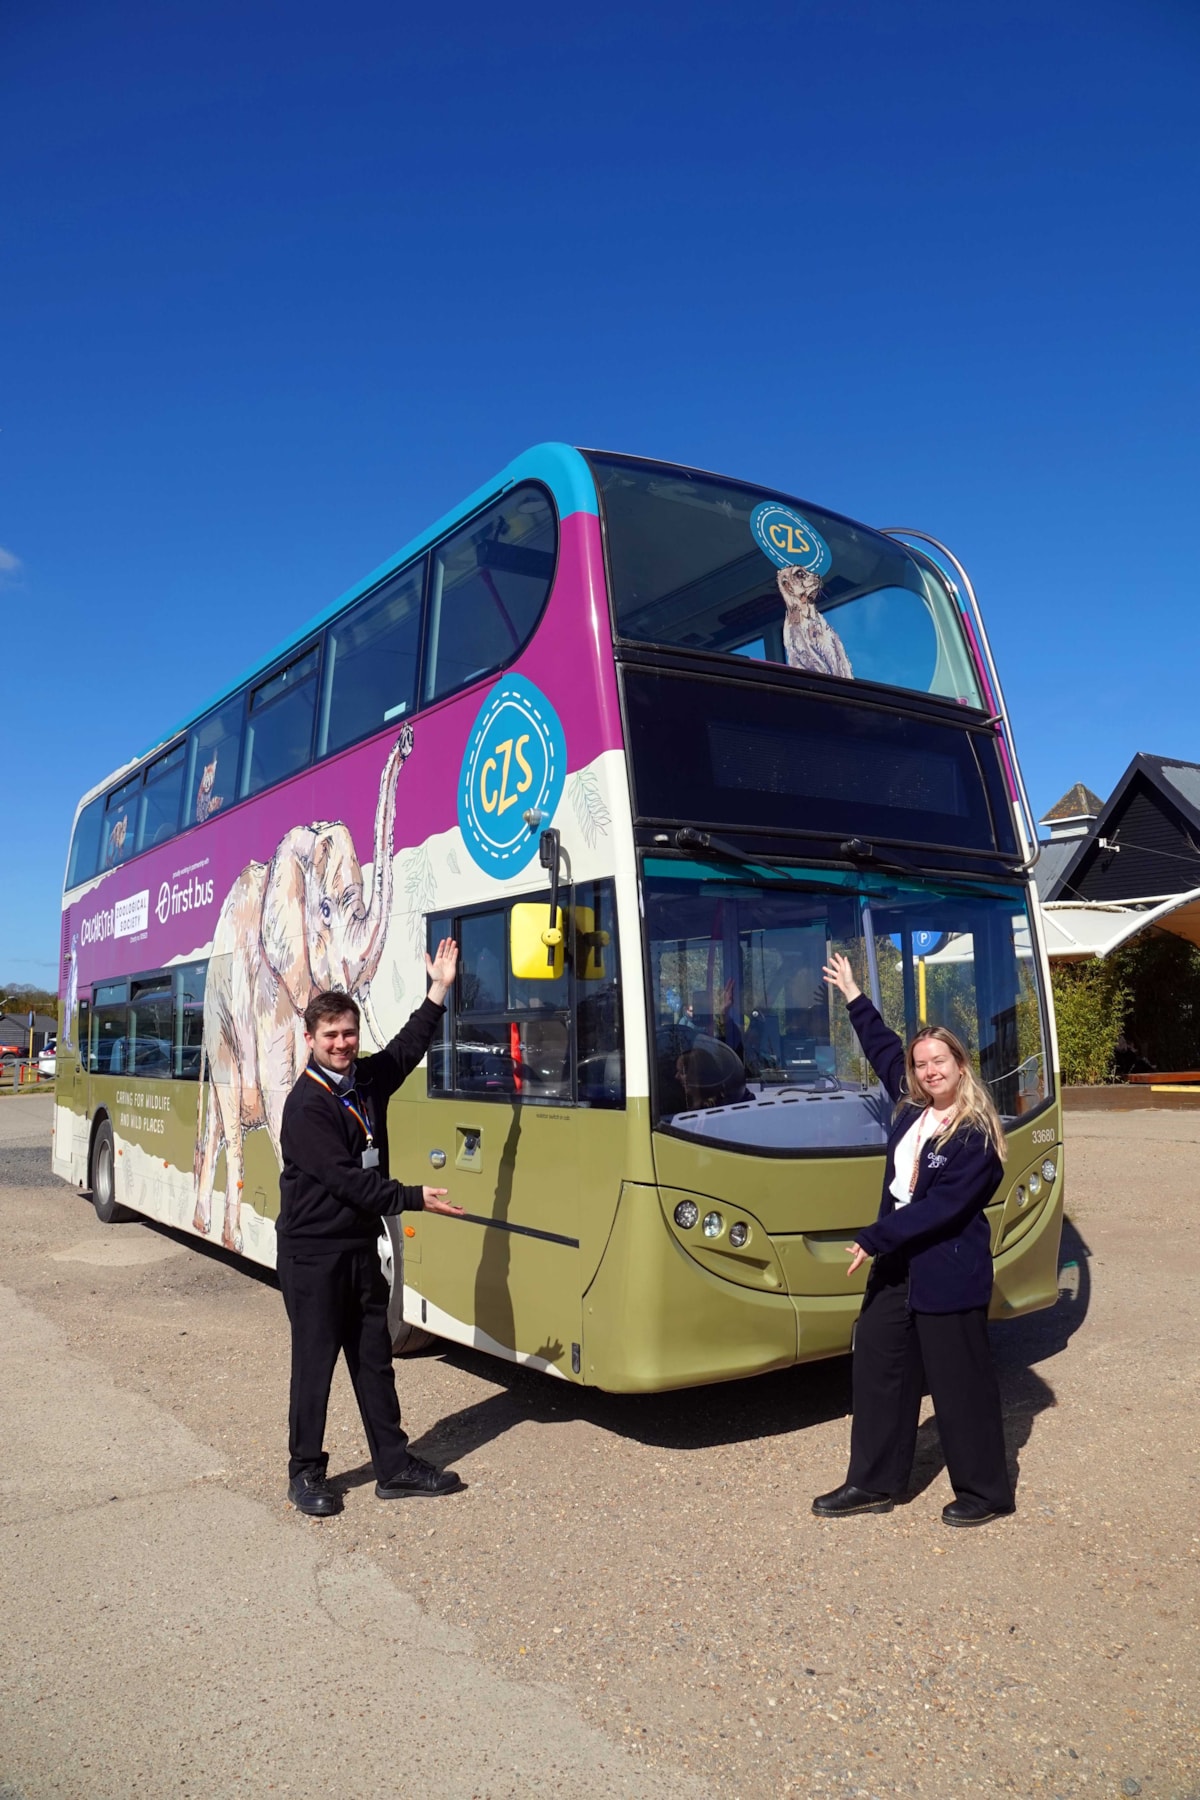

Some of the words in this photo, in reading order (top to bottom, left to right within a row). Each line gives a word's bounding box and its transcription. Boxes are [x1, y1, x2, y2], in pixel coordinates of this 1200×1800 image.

[769, 523, 811, 554] CZS
[480, 734, 533, 816] CZS
[116, 897, 147, 918] ZOOLOGICAL
[81, 908, 115, 947] COLCHESTER
[120, 914, 142, 932] SOCIETY
[920, 932, 928, 944] P
[116, 1090, 133, 1106] CARING
[134, 1092, 144, 1108] FOR
[145, 1094, 170, 1112] WILDLIFE
[120, 1112, 129, 1127] AND
[130, 1114, 142, 1130] WILD
[143, 1117, 165, 1134] PLACES
[1032, 1128, 1055, 1144] 33680
